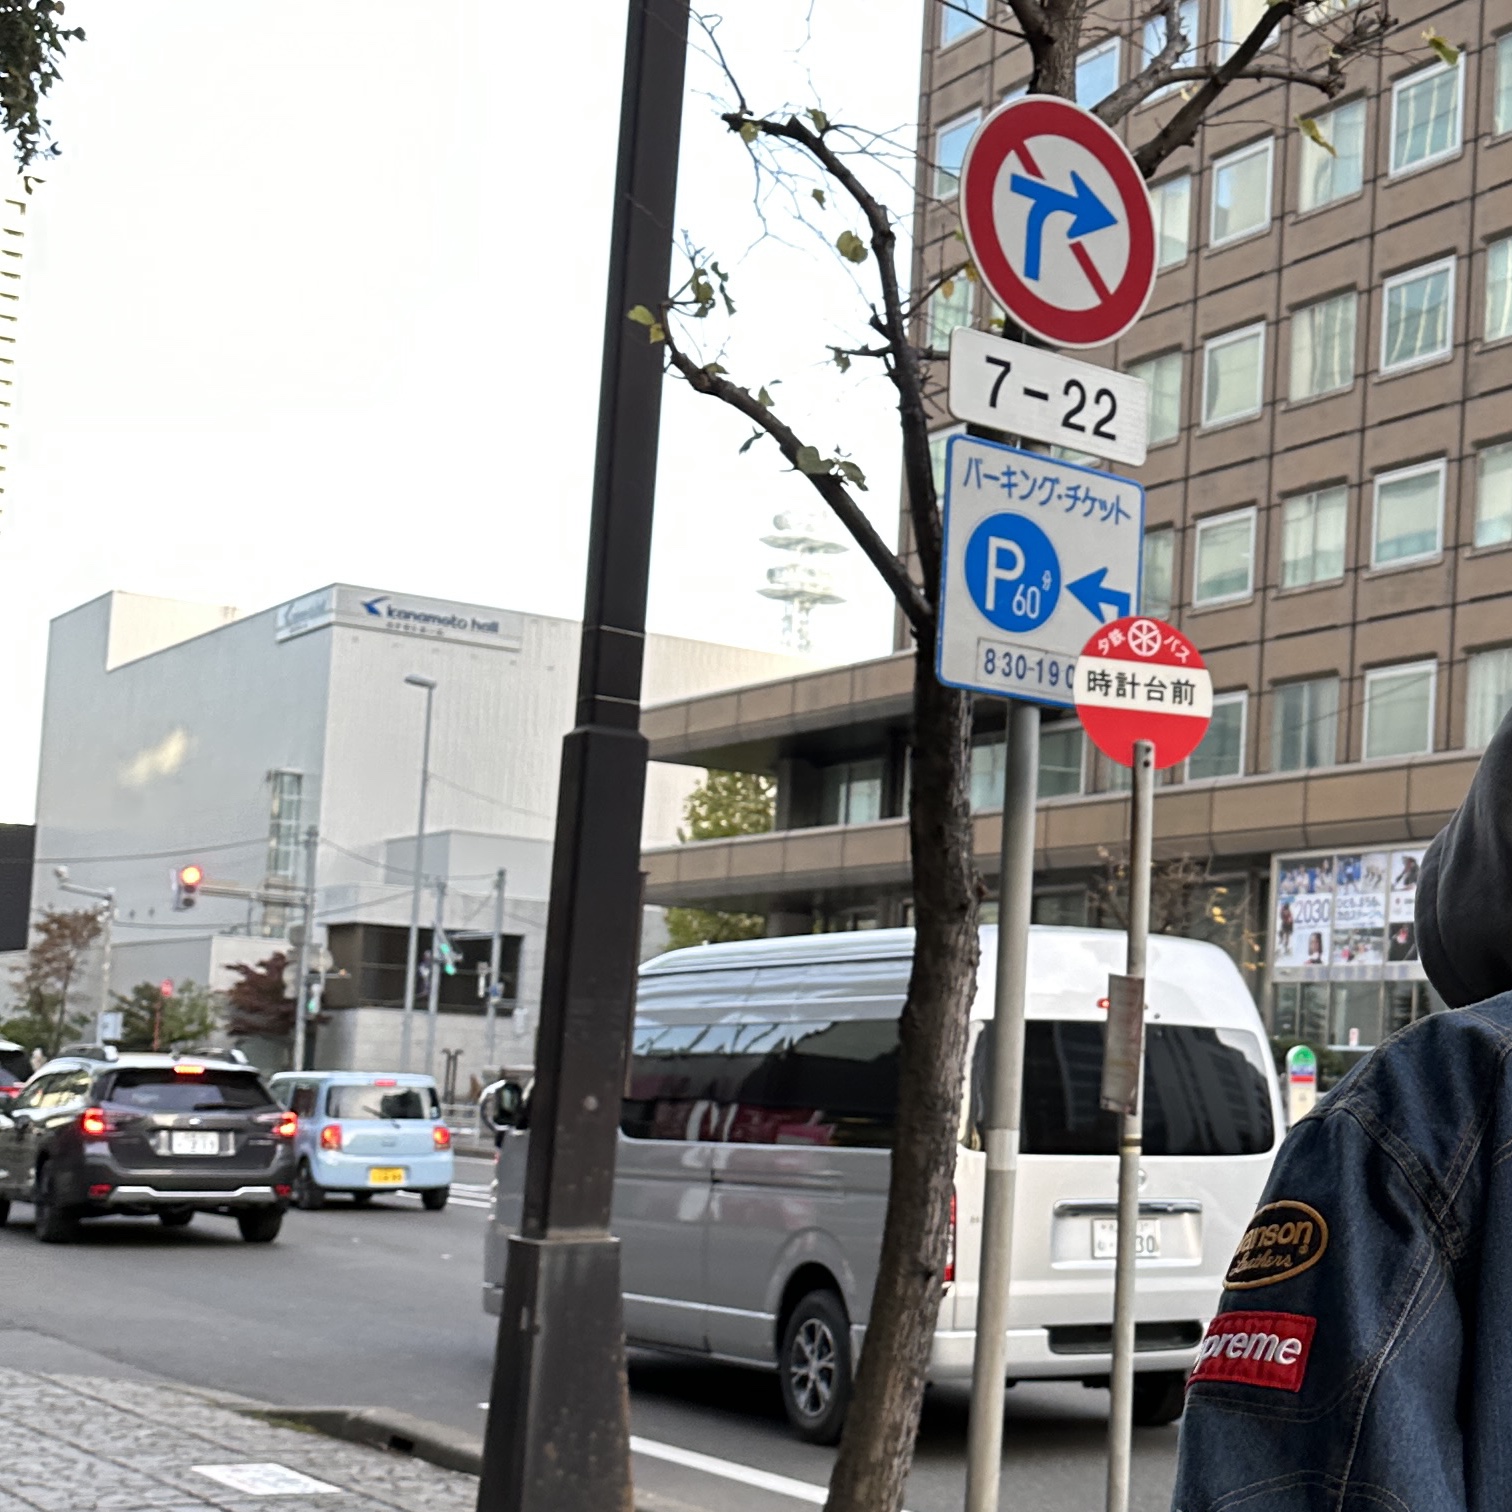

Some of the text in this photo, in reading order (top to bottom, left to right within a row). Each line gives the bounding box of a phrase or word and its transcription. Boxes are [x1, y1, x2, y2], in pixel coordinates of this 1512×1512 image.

[985, 355, 1117, 441] 7-22
[985, 535, 1025, 611] P
[387, 604, 467, 629] kanamoto
[471, 617, 498, 633] hall
[1086, 669, 1196, 707] 時計台前
[1294, 899, 1330, 923] 2030
[1235, 1221, 1313, 1254] anson
[1193, 1332, 1303, 1374] preme
